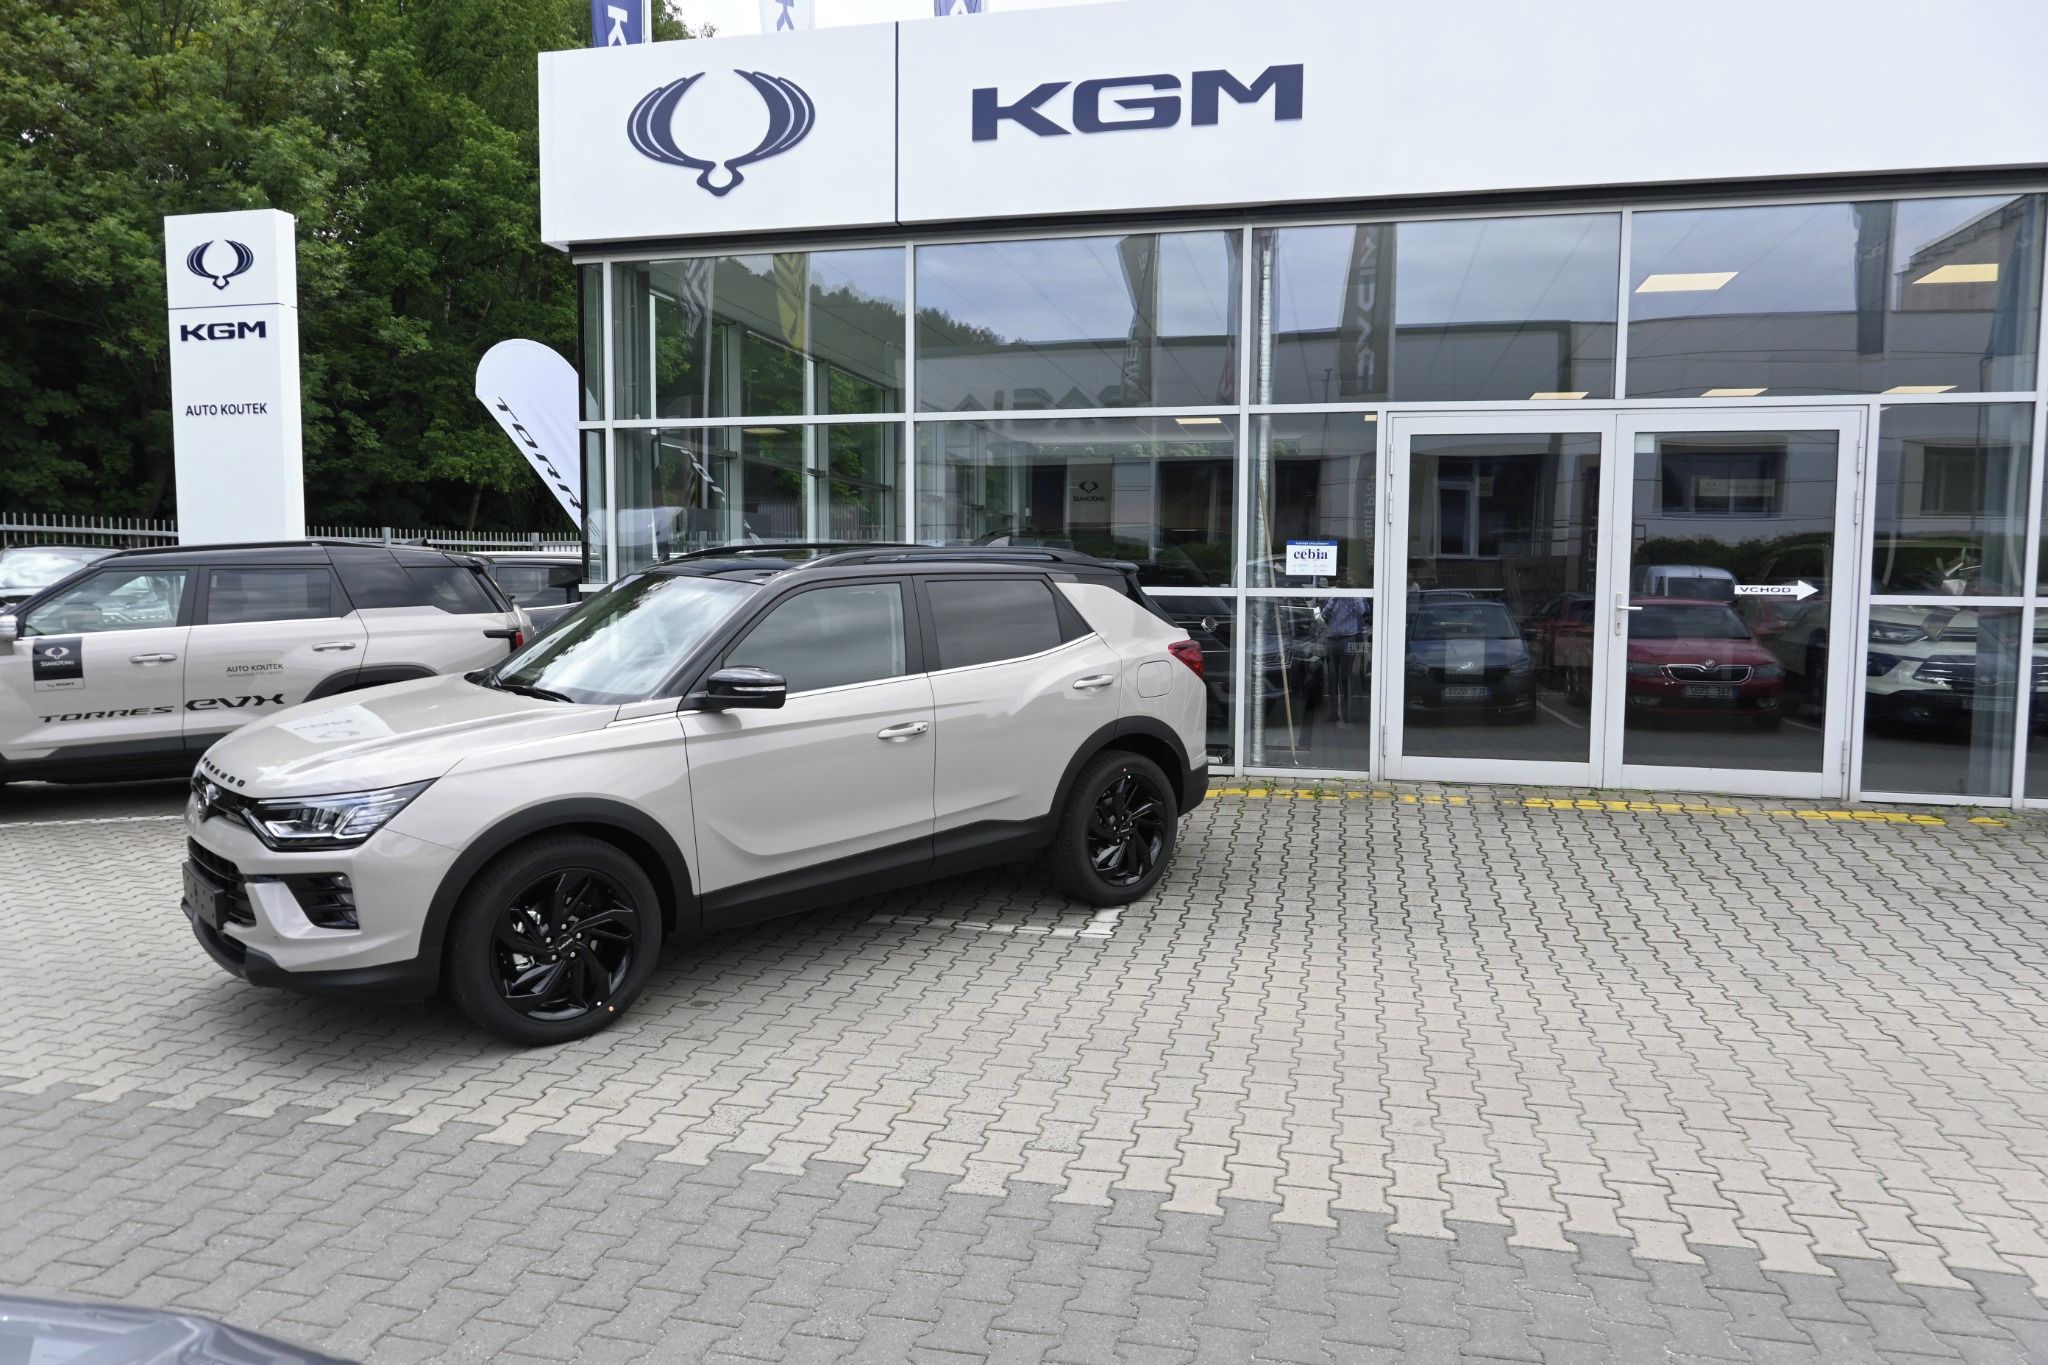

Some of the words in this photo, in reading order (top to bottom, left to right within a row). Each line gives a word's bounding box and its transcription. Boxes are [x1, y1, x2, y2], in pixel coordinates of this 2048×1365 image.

[972, 63, 1304, 142] KGM
[180, 320, 267, 342] KGM
[185, 404, 218, 417] AUTO
[220, 402, 268, 416] KOUTEK
[1293, 548, 1329, 560] cebia
[226, 665, 249, 673] AUTO
[250, 663, 284, 671] KOUTEK
[38, 705, 175, 723] TORRES
